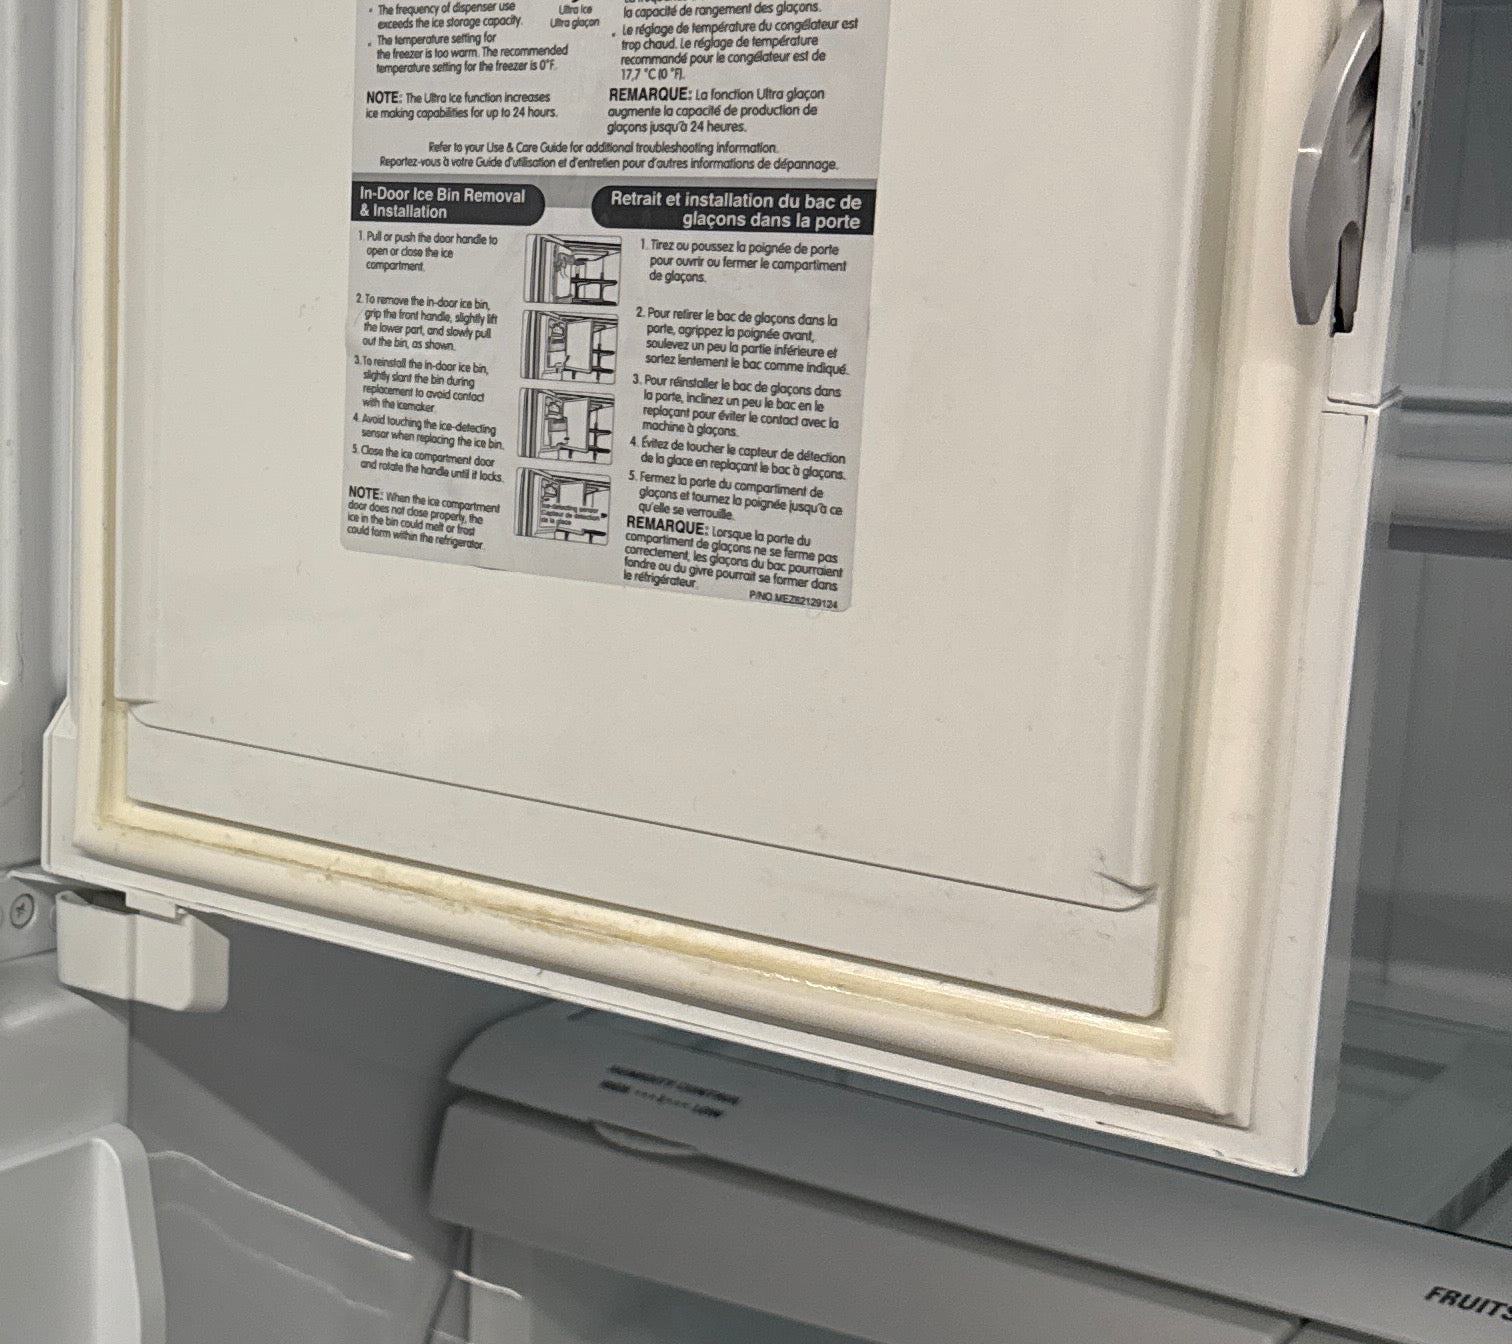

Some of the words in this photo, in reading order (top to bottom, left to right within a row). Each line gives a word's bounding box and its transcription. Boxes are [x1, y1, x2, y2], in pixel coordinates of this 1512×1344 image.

[366, 90, 403, 105] NOTE:
[608, 86, 693, 102] REMARQUE:
[359, 185, 411, 201] In-Door
[412, 186, 434, 202] Ice
[436, 187, 460, 202] Bin
[463, 187, 526, 204] Removal
[611, 190, 663, 206] Retrait
[665, 192, 682, 207] et
[684, 191, 775, 209] installation
[777, 193, 801, 209] du
[804, 193, 836, 210] bac
[839, 194, 863, 210] de
[359, 202, 370, 217] &
[373, 203, 448, 219] Installation
[682, 210, 747, 230] glaçons
[749, 211, 792, 228] dans
[795, 212, 811, 228] la
[814, 214, 861, 233] porte
[348, 484, 384, 501] NOTE:
[626, 514, 709, 537] REMARQUE:
